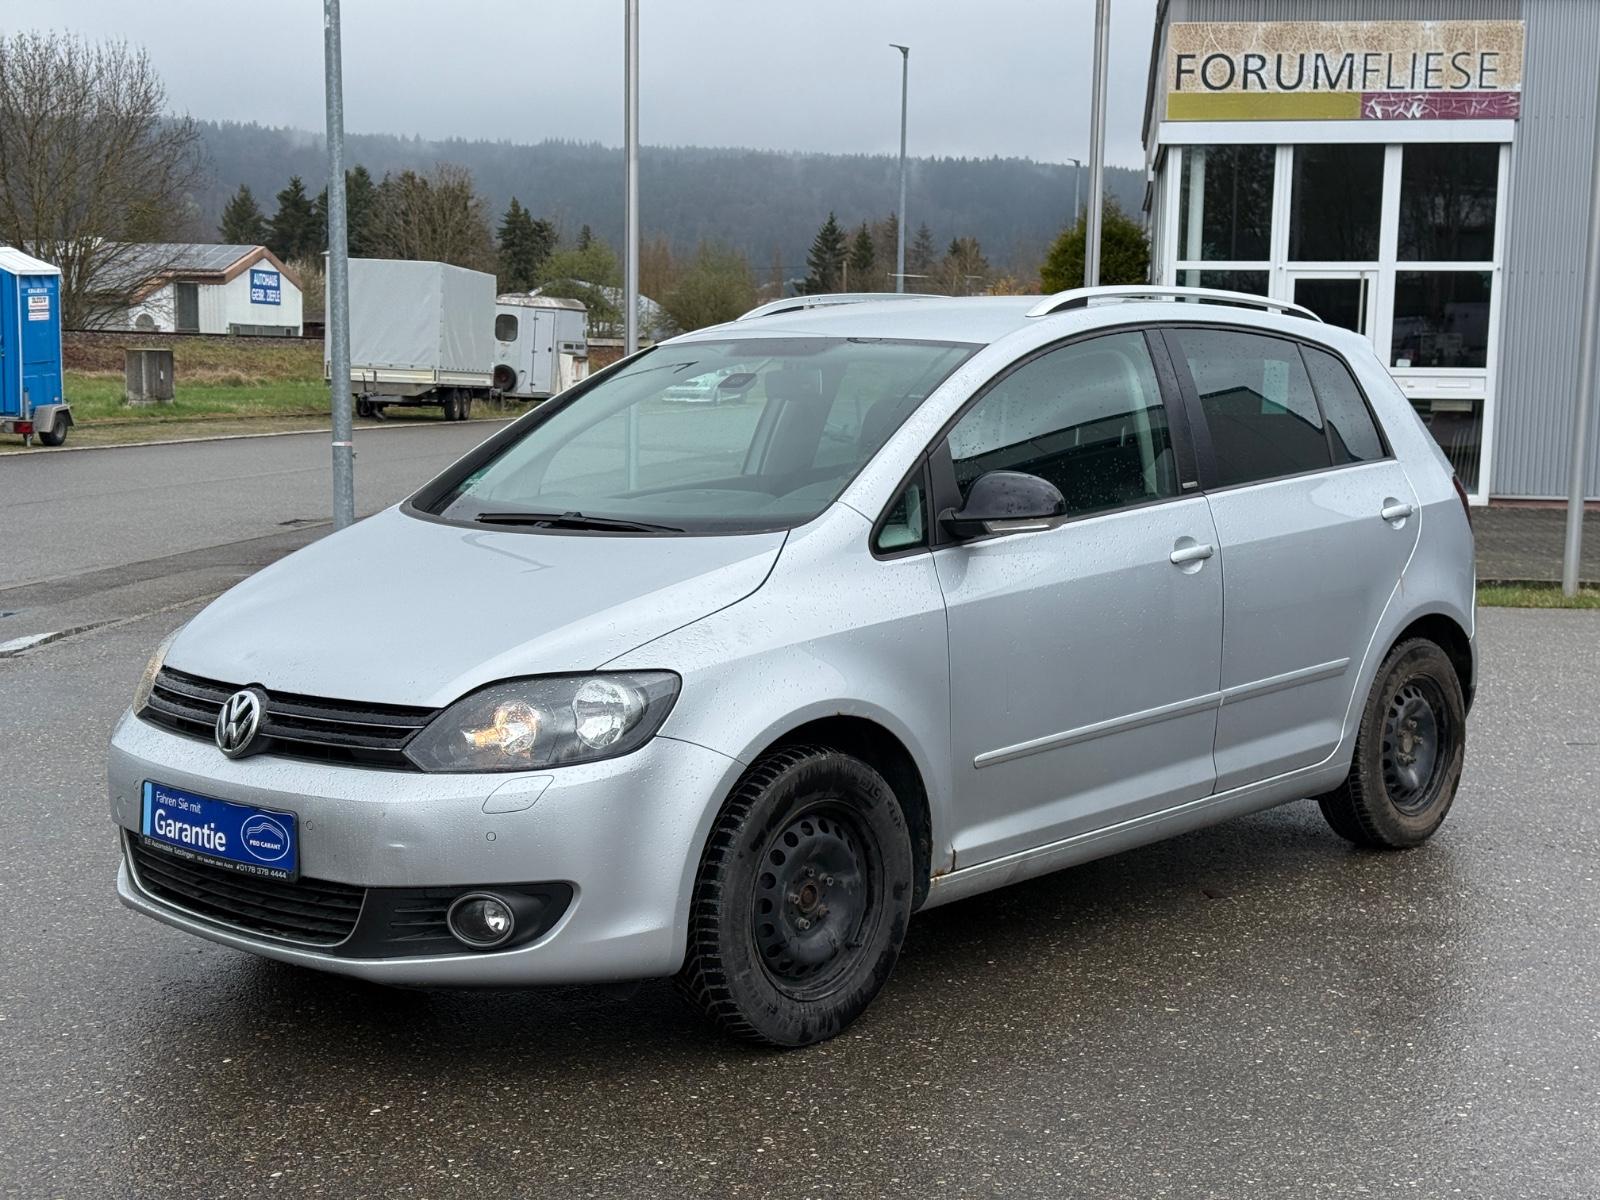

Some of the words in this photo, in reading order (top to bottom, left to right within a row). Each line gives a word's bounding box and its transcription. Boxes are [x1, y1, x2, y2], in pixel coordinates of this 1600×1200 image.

[1175, 52, 1500, 91] FORUMFLIESE
[253, 273, 278, 287] AUTOHAUS
[156, 791, 177, 807] Fahren
[178, 797, 189, 810] Sie
[189, 801, 202, 814] mit
[154, 808, 227, 852] Garantie
